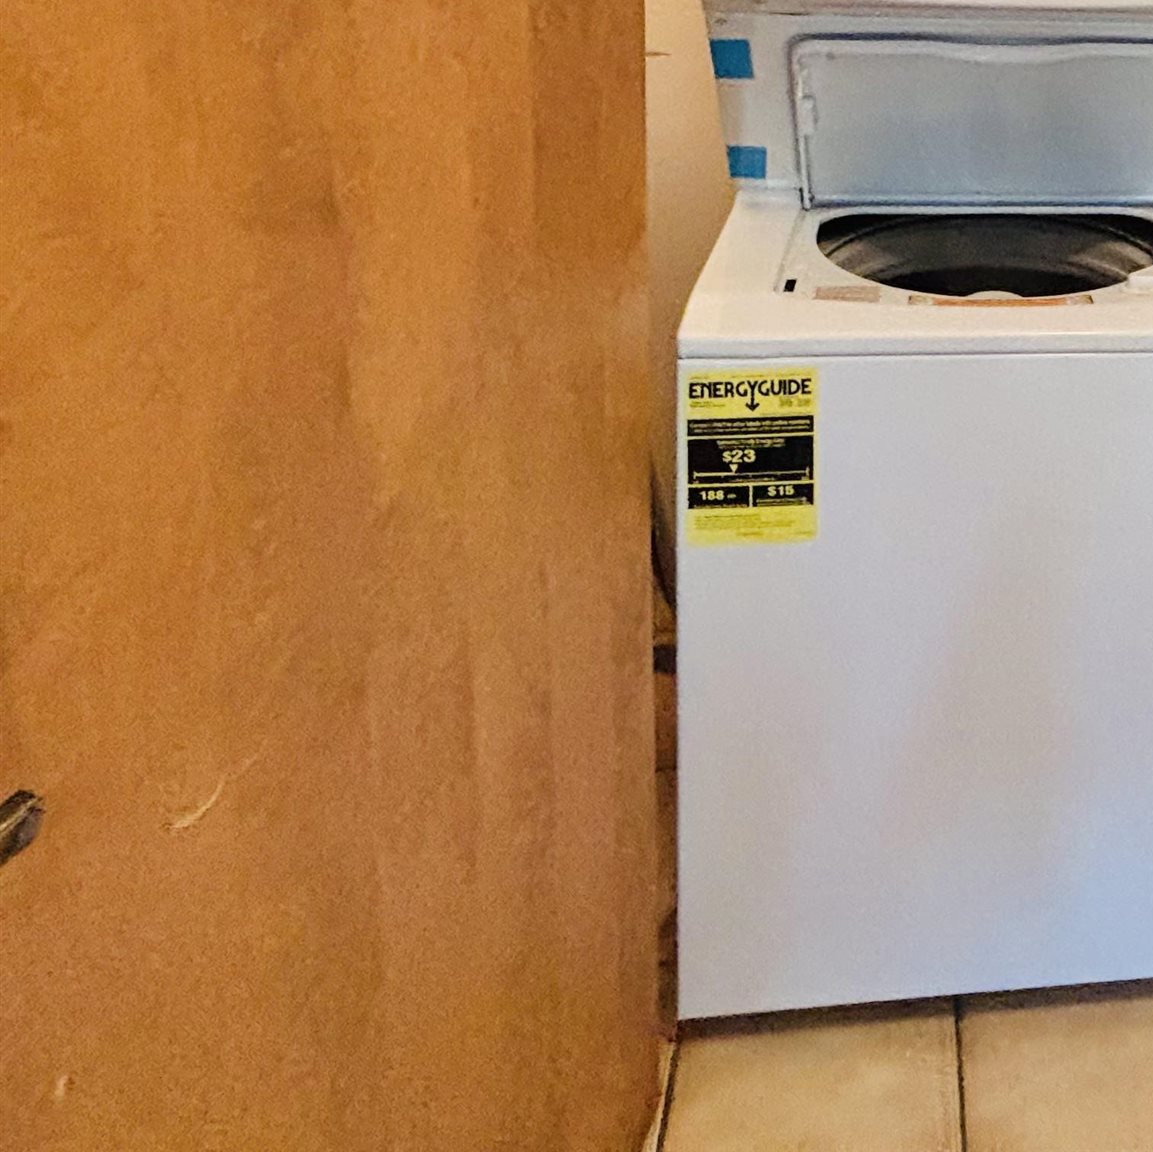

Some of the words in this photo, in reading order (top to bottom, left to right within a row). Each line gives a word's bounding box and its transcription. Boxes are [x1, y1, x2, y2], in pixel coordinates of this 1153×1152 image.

[689, 378, 812, 399] ENERGYGUIDE
[722, 449, 756, 463] $23
[767, 485, 795, 497] $15
